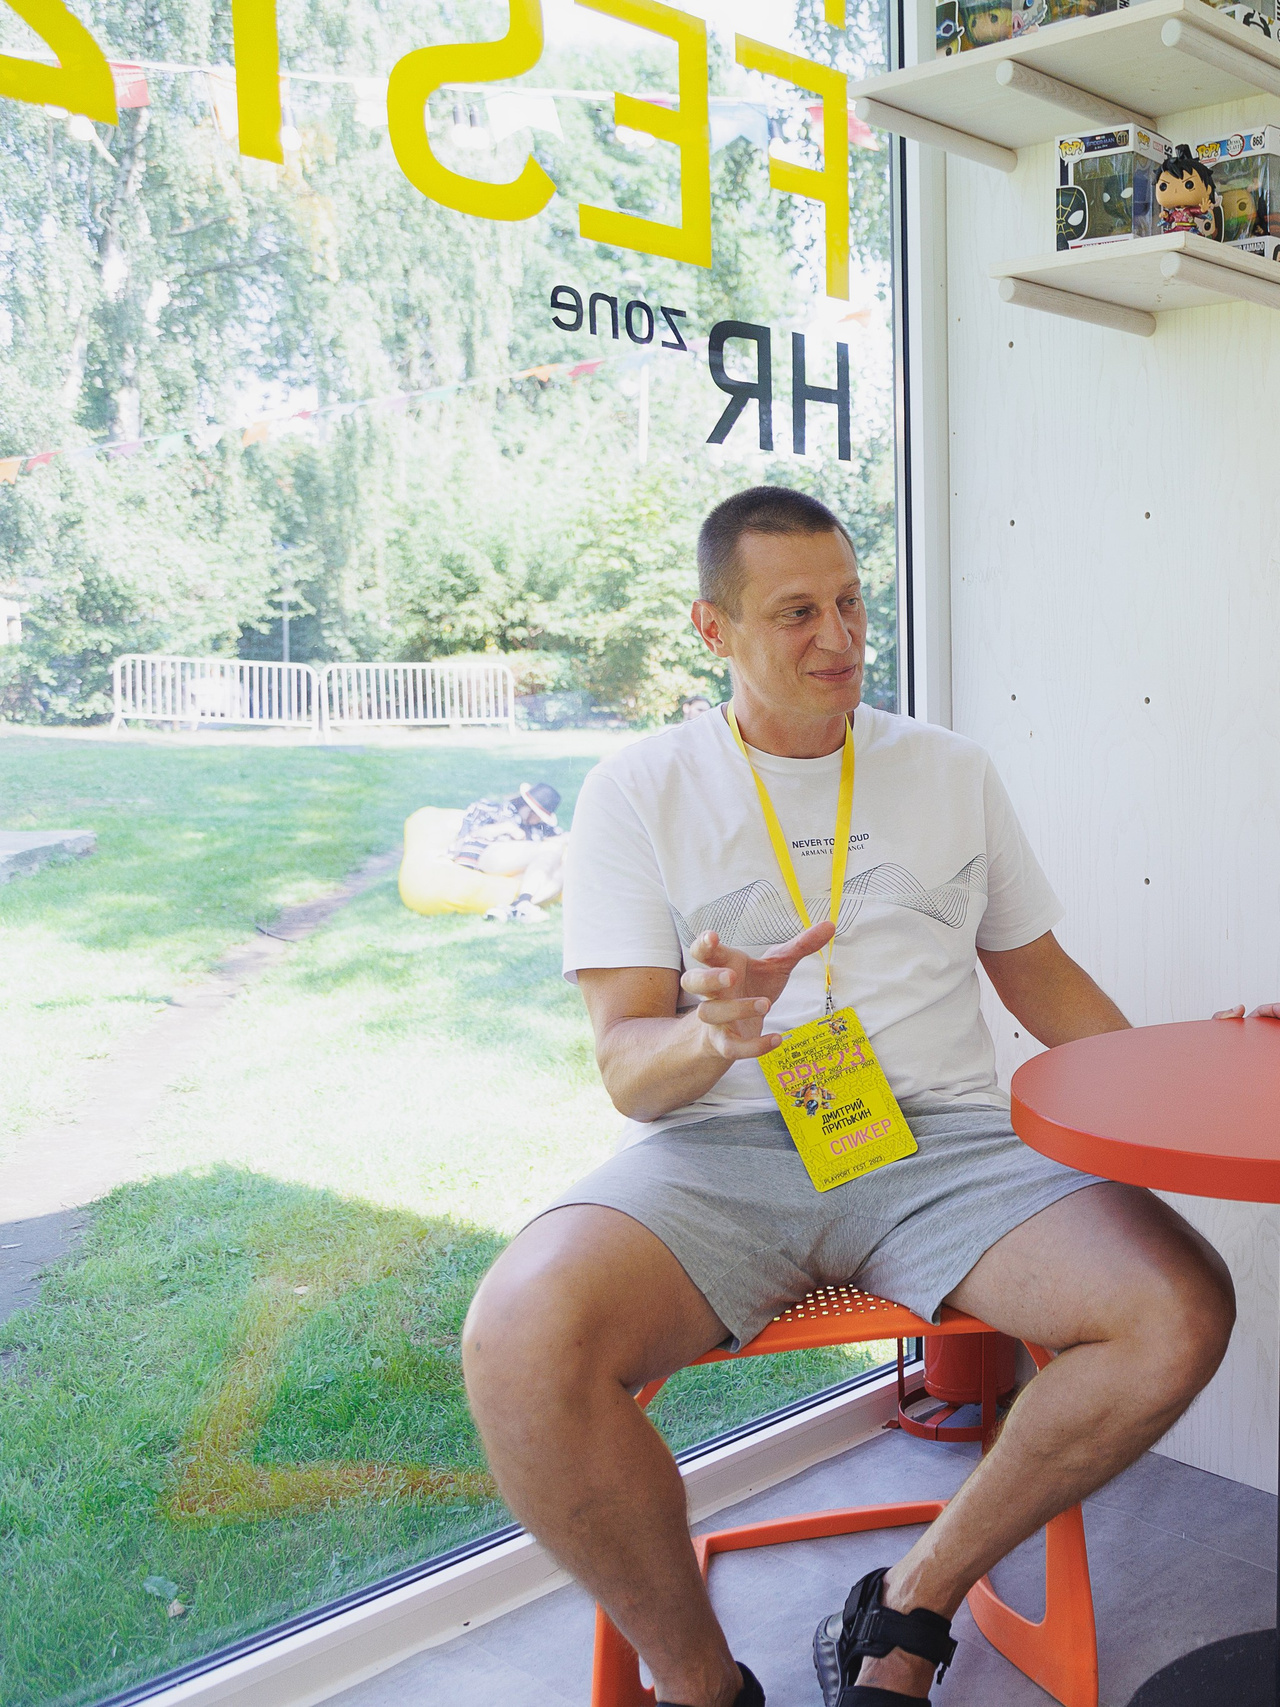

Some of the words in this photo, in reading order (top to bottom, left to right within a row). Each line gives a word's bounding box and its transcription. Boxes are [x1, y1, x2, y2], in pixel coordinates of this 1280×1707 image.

[1059, 141, 1084, 158] POP!
[1196, 143, 1220, 160] POP!
[792, 839, 822, 849] NEVER
[823, 838, 835, 846] TO
[848, 833, 870, 843] OUD
[801, 849, 828, 857] ARMANI
[845, 1066, 859, 1075] FEST
[822, 1098, 865, 1125] ДМИТРИЙ
[822, 1108, 872, 1136] ПРИТЫКИН
[829, 1118, 892, 1156] СПИКЕР
[852, 1162, 867, 1172] FEST
